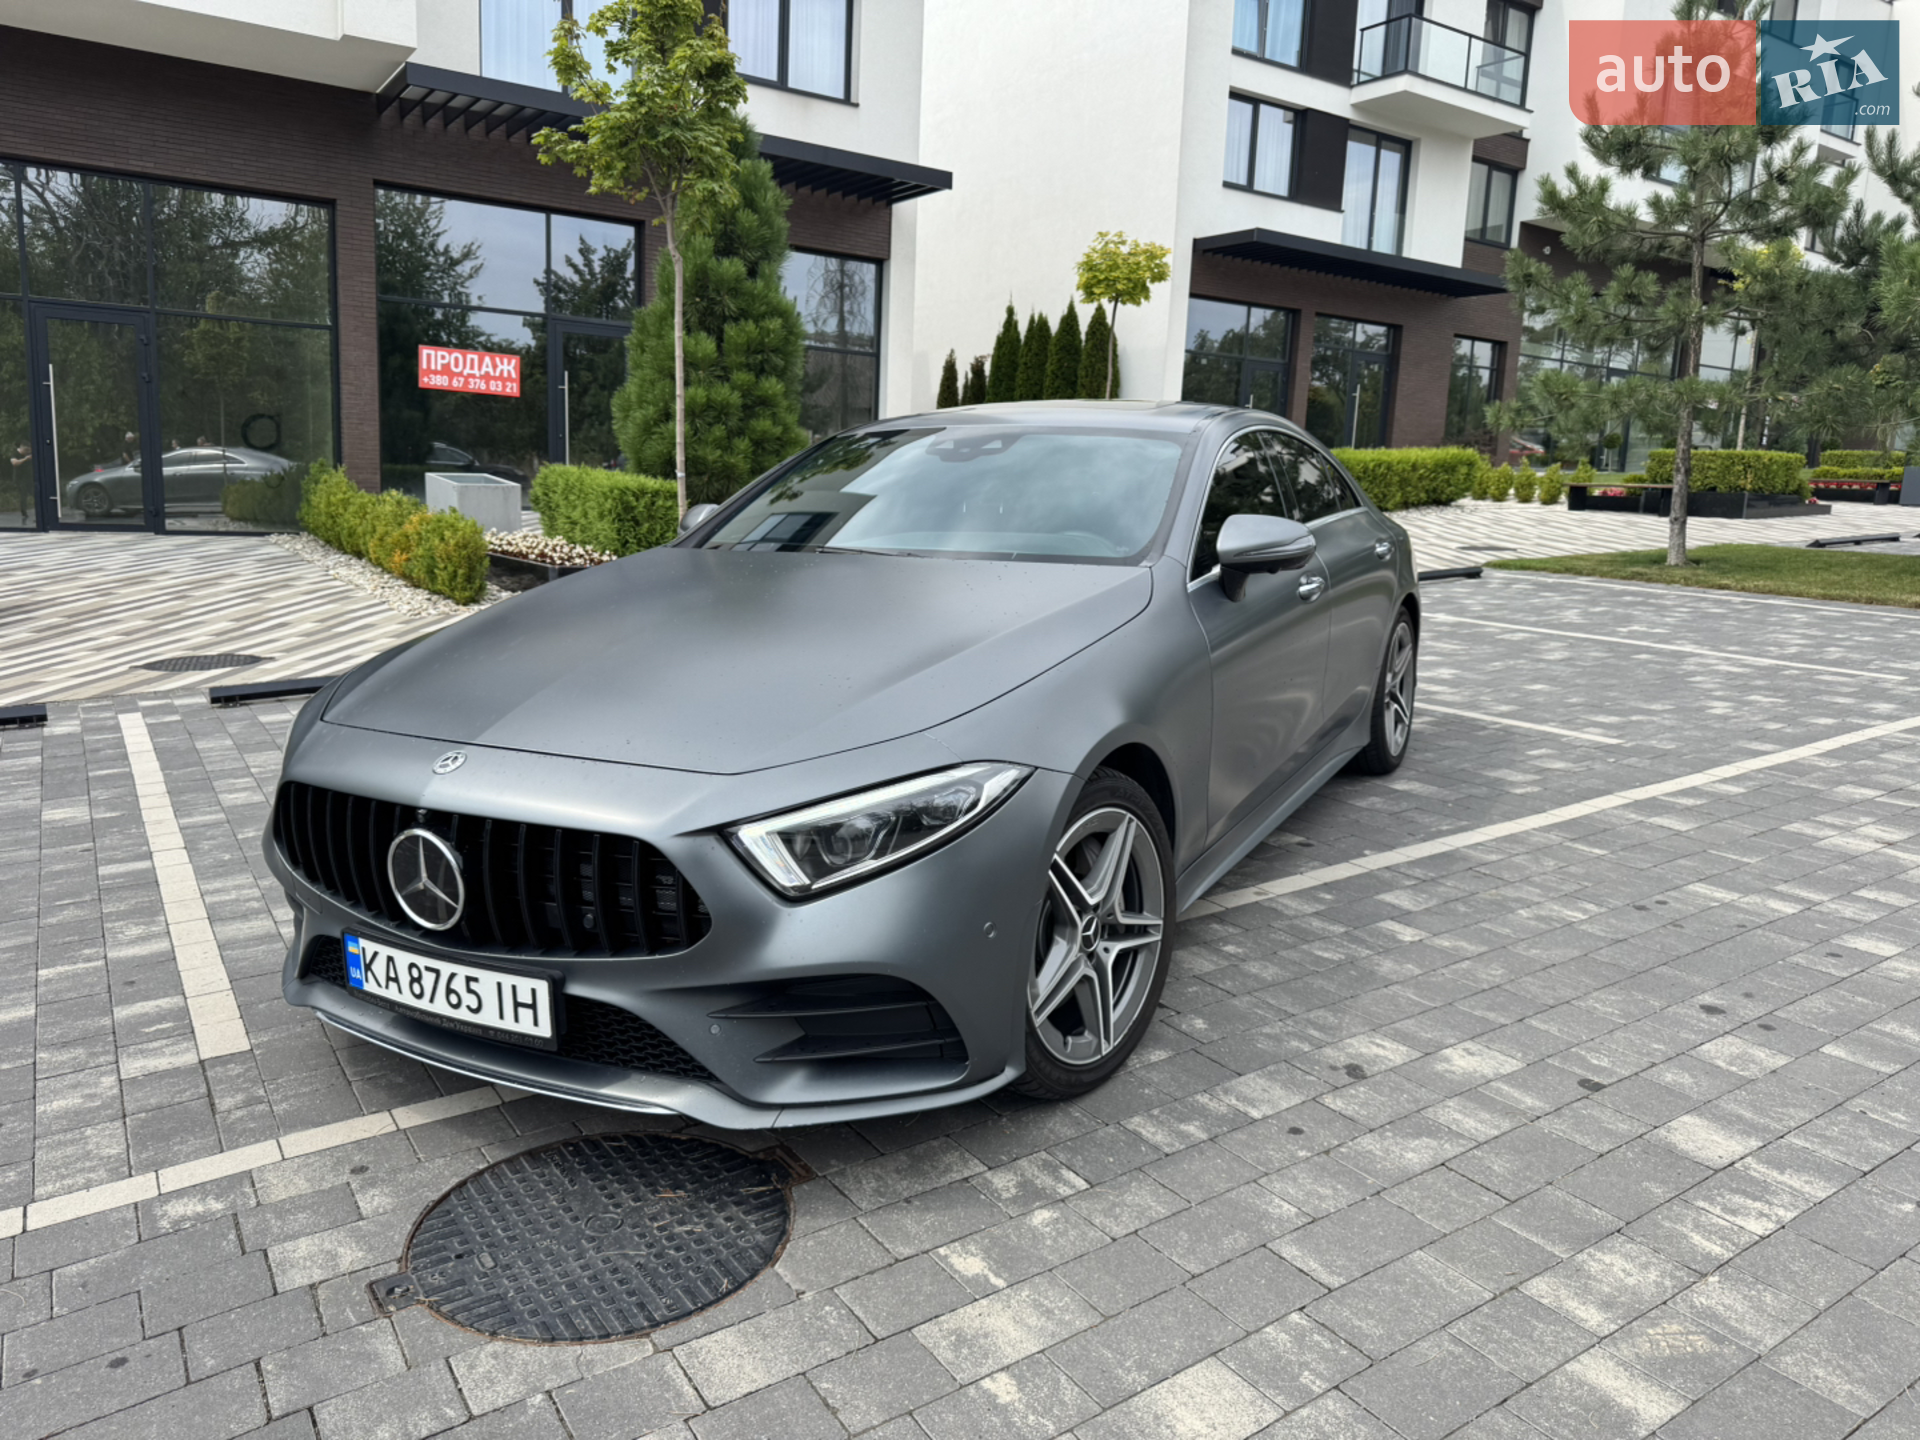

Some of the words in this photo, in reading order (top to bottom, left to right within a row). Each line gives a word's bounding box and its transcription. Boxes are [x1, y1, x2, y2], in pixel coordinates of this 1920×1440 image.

[422, 349, 516, 379] ПРОДАЖ
[422, 374, 449, 387] +380
[452, 377, 464, 388] 67
[468, 378, 486, 391] 376
[489, 380, 502, 392] 03
[506, 382, 518, 394] 21
[350, 966, 362, 980] UA
[361, 946, 403, 995] KA
[407, 962, 483, 1015] 8765
[496, 981, 540, 1028] IH
